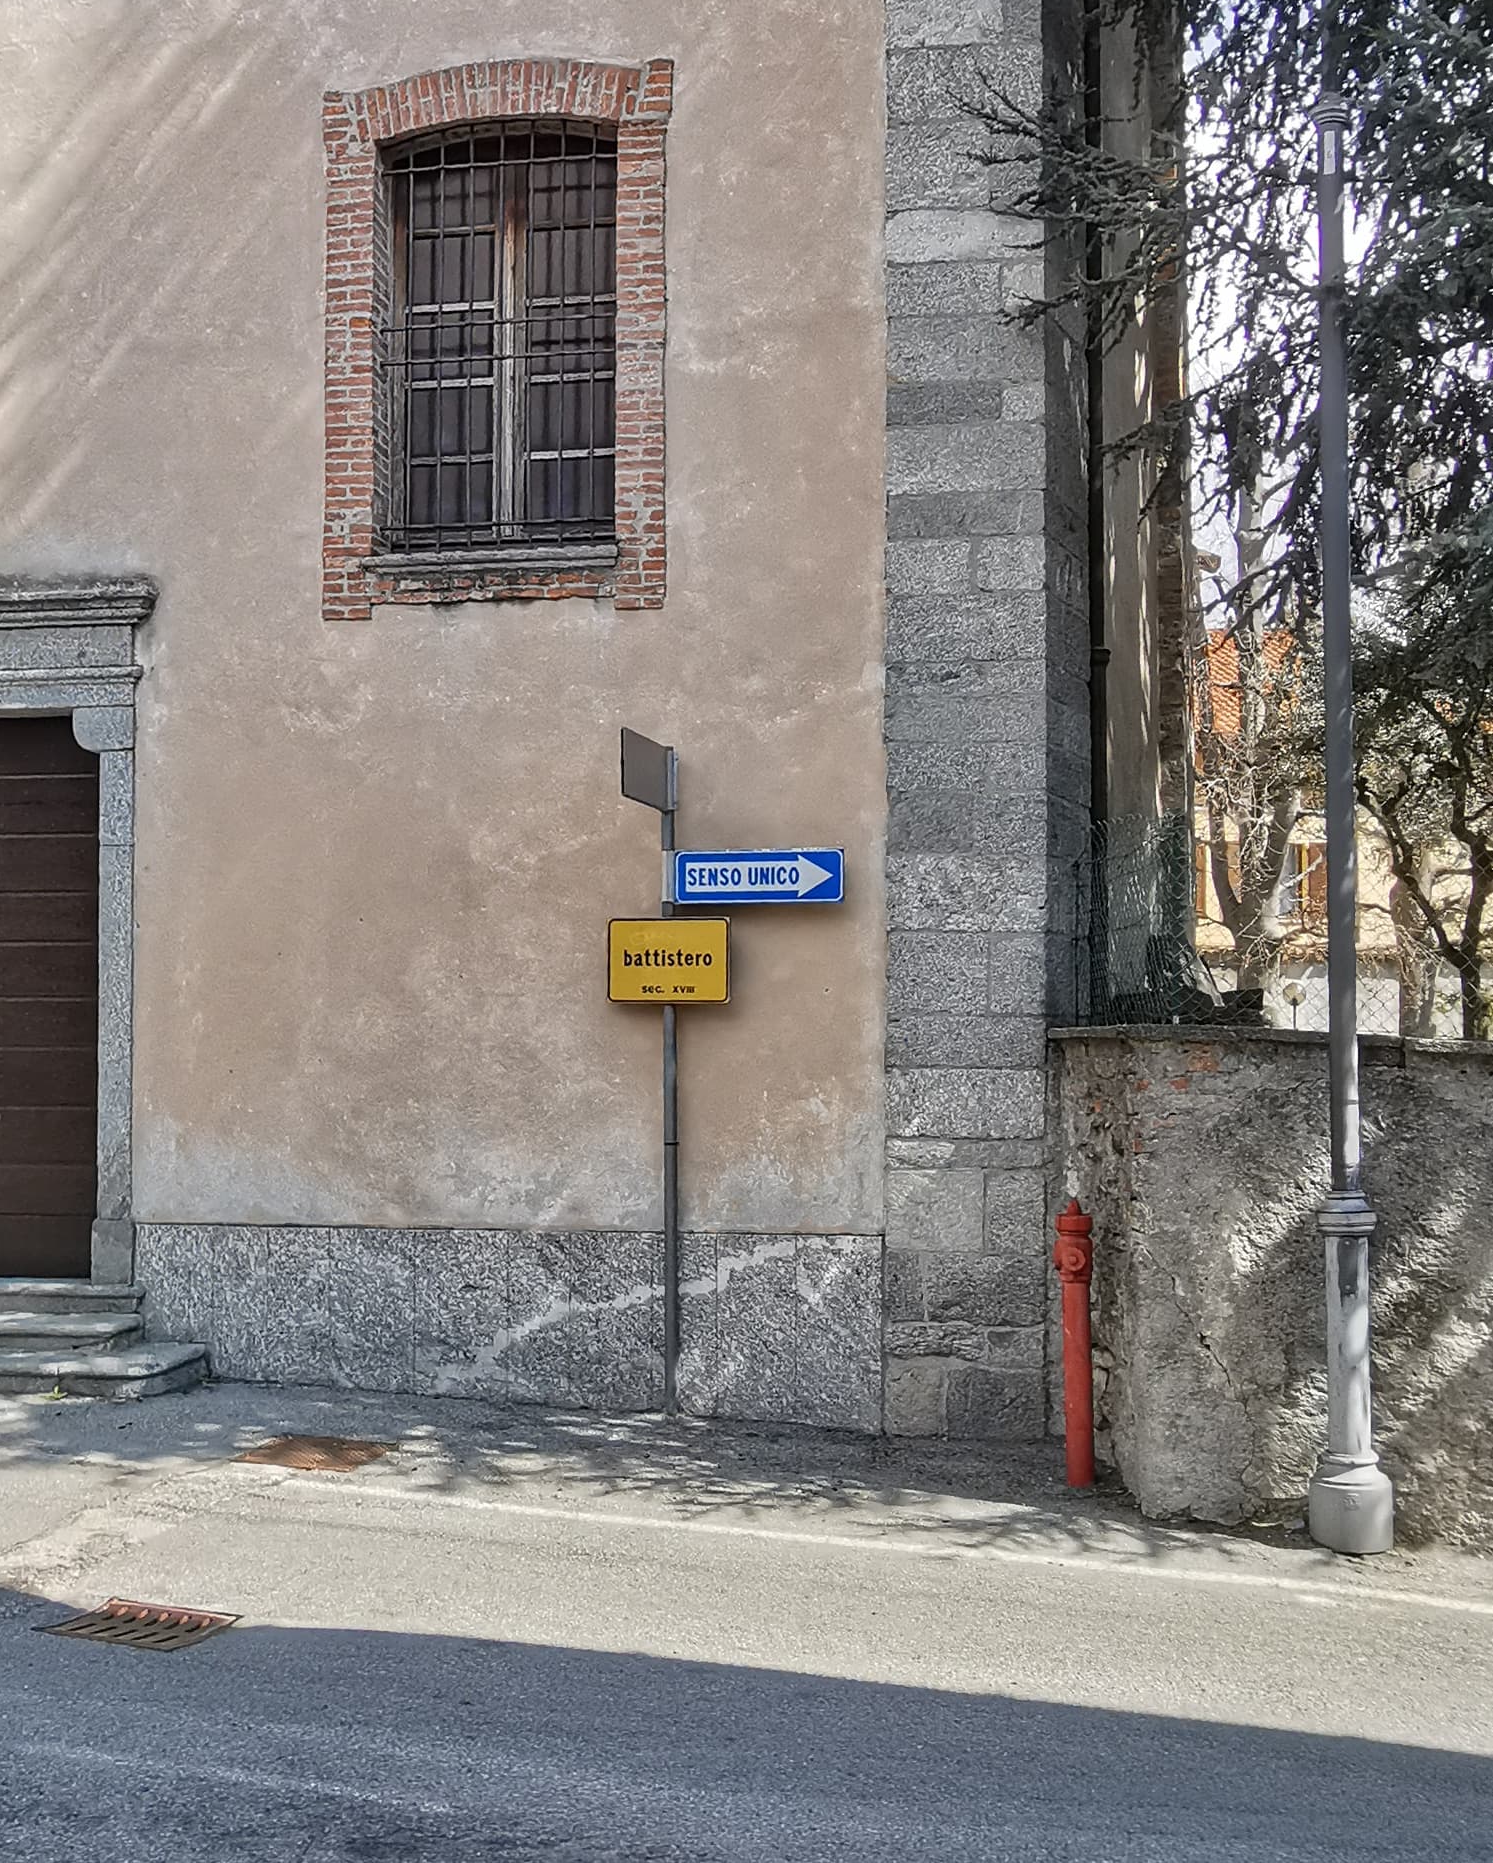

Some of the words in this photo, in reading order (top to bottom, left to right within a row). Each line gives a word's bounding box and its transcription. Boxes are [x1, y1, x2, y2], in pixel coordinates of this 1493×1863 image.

[687, 867, 742, 886] SENSO
[748, 866, 800, 886] UNICO
[623, 949, 712, 966] battistero
